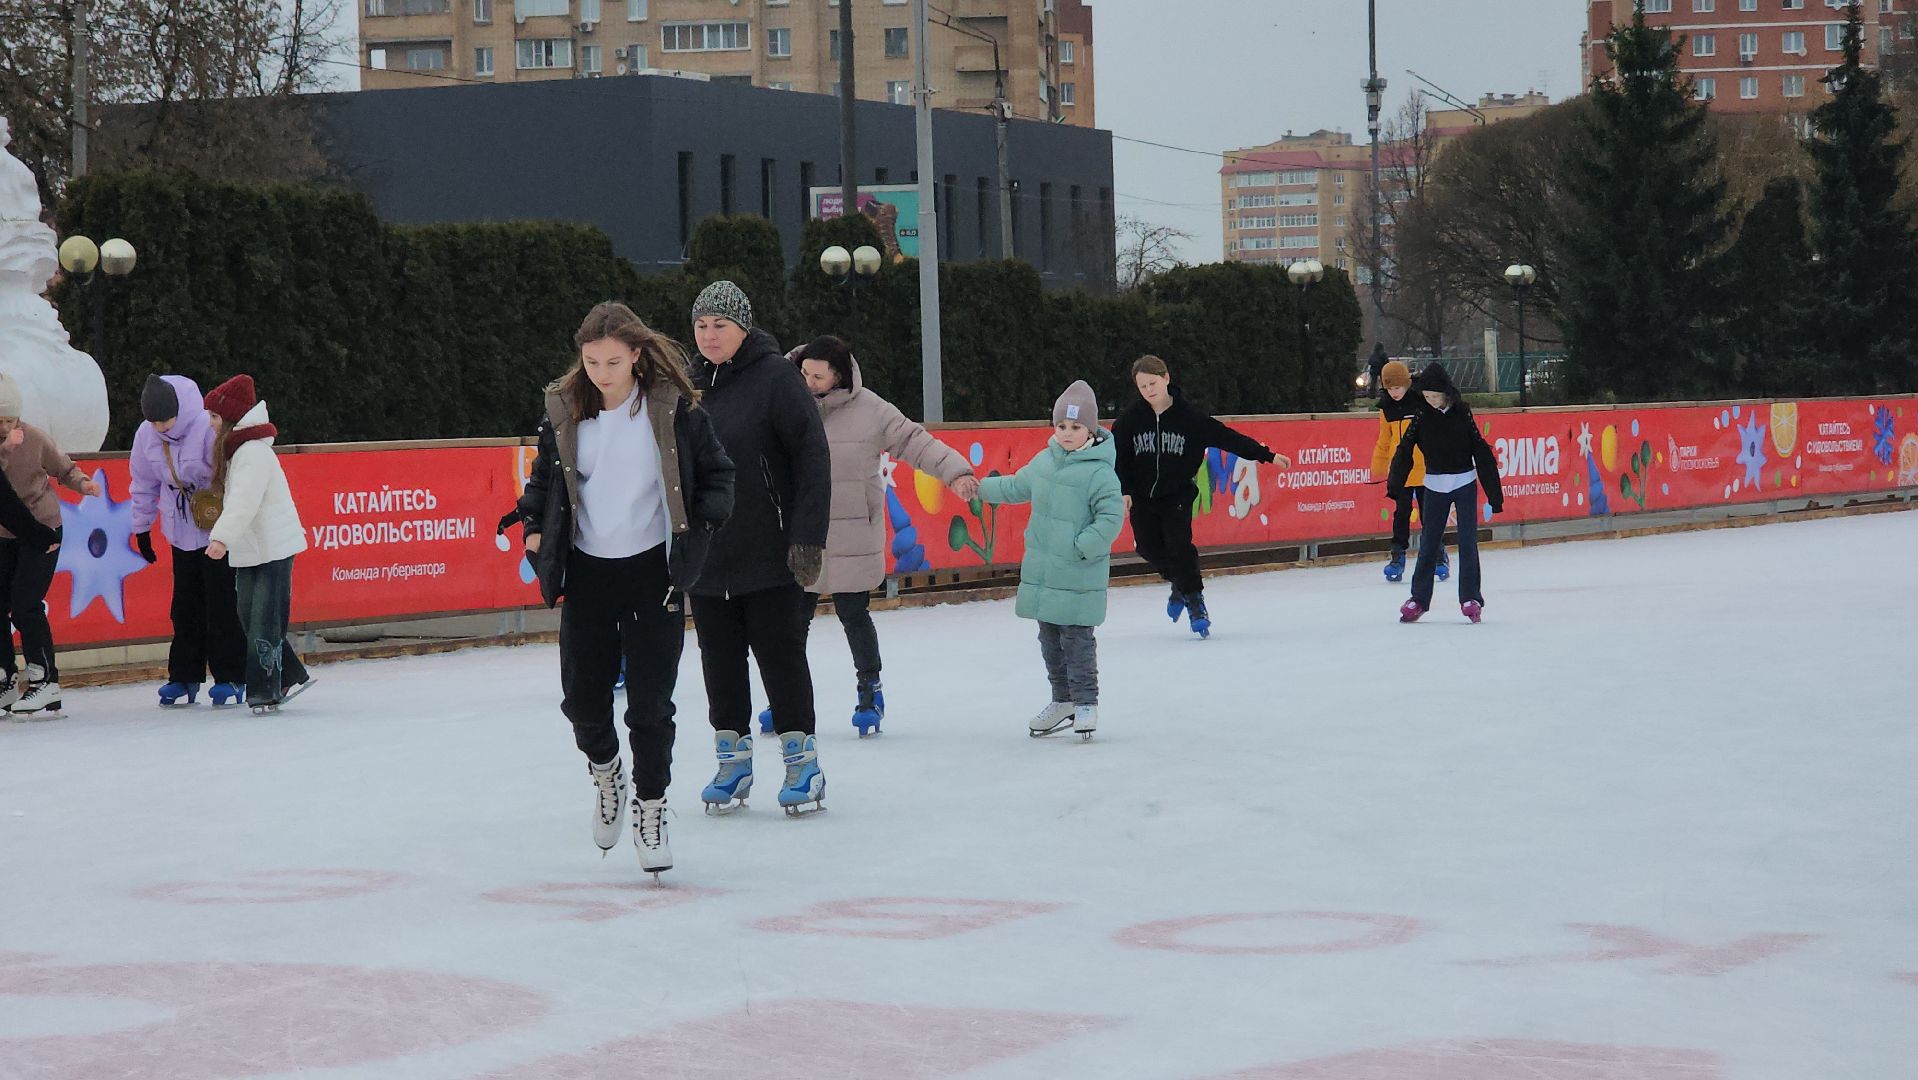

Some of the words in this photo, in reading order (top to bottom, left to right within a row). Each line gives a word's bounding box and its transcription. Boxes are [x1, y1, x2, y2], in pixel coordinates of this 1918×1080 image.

[1298, 444, 1352, 465] КАТАЙТЕСЬ
[1277, 472, 1287, 488] С
[1287, 468, 1371, 490] УДОВОЛЬСТВИЕМ!
[333, 485, 437, 514] КАТАЙТЕСЬ
[312, 517, 476, 551] УДОВОЛЬСТВИЕМ!
[331, 566, 380, 582] Команда
[381, 561, 446, 582] губернатора
